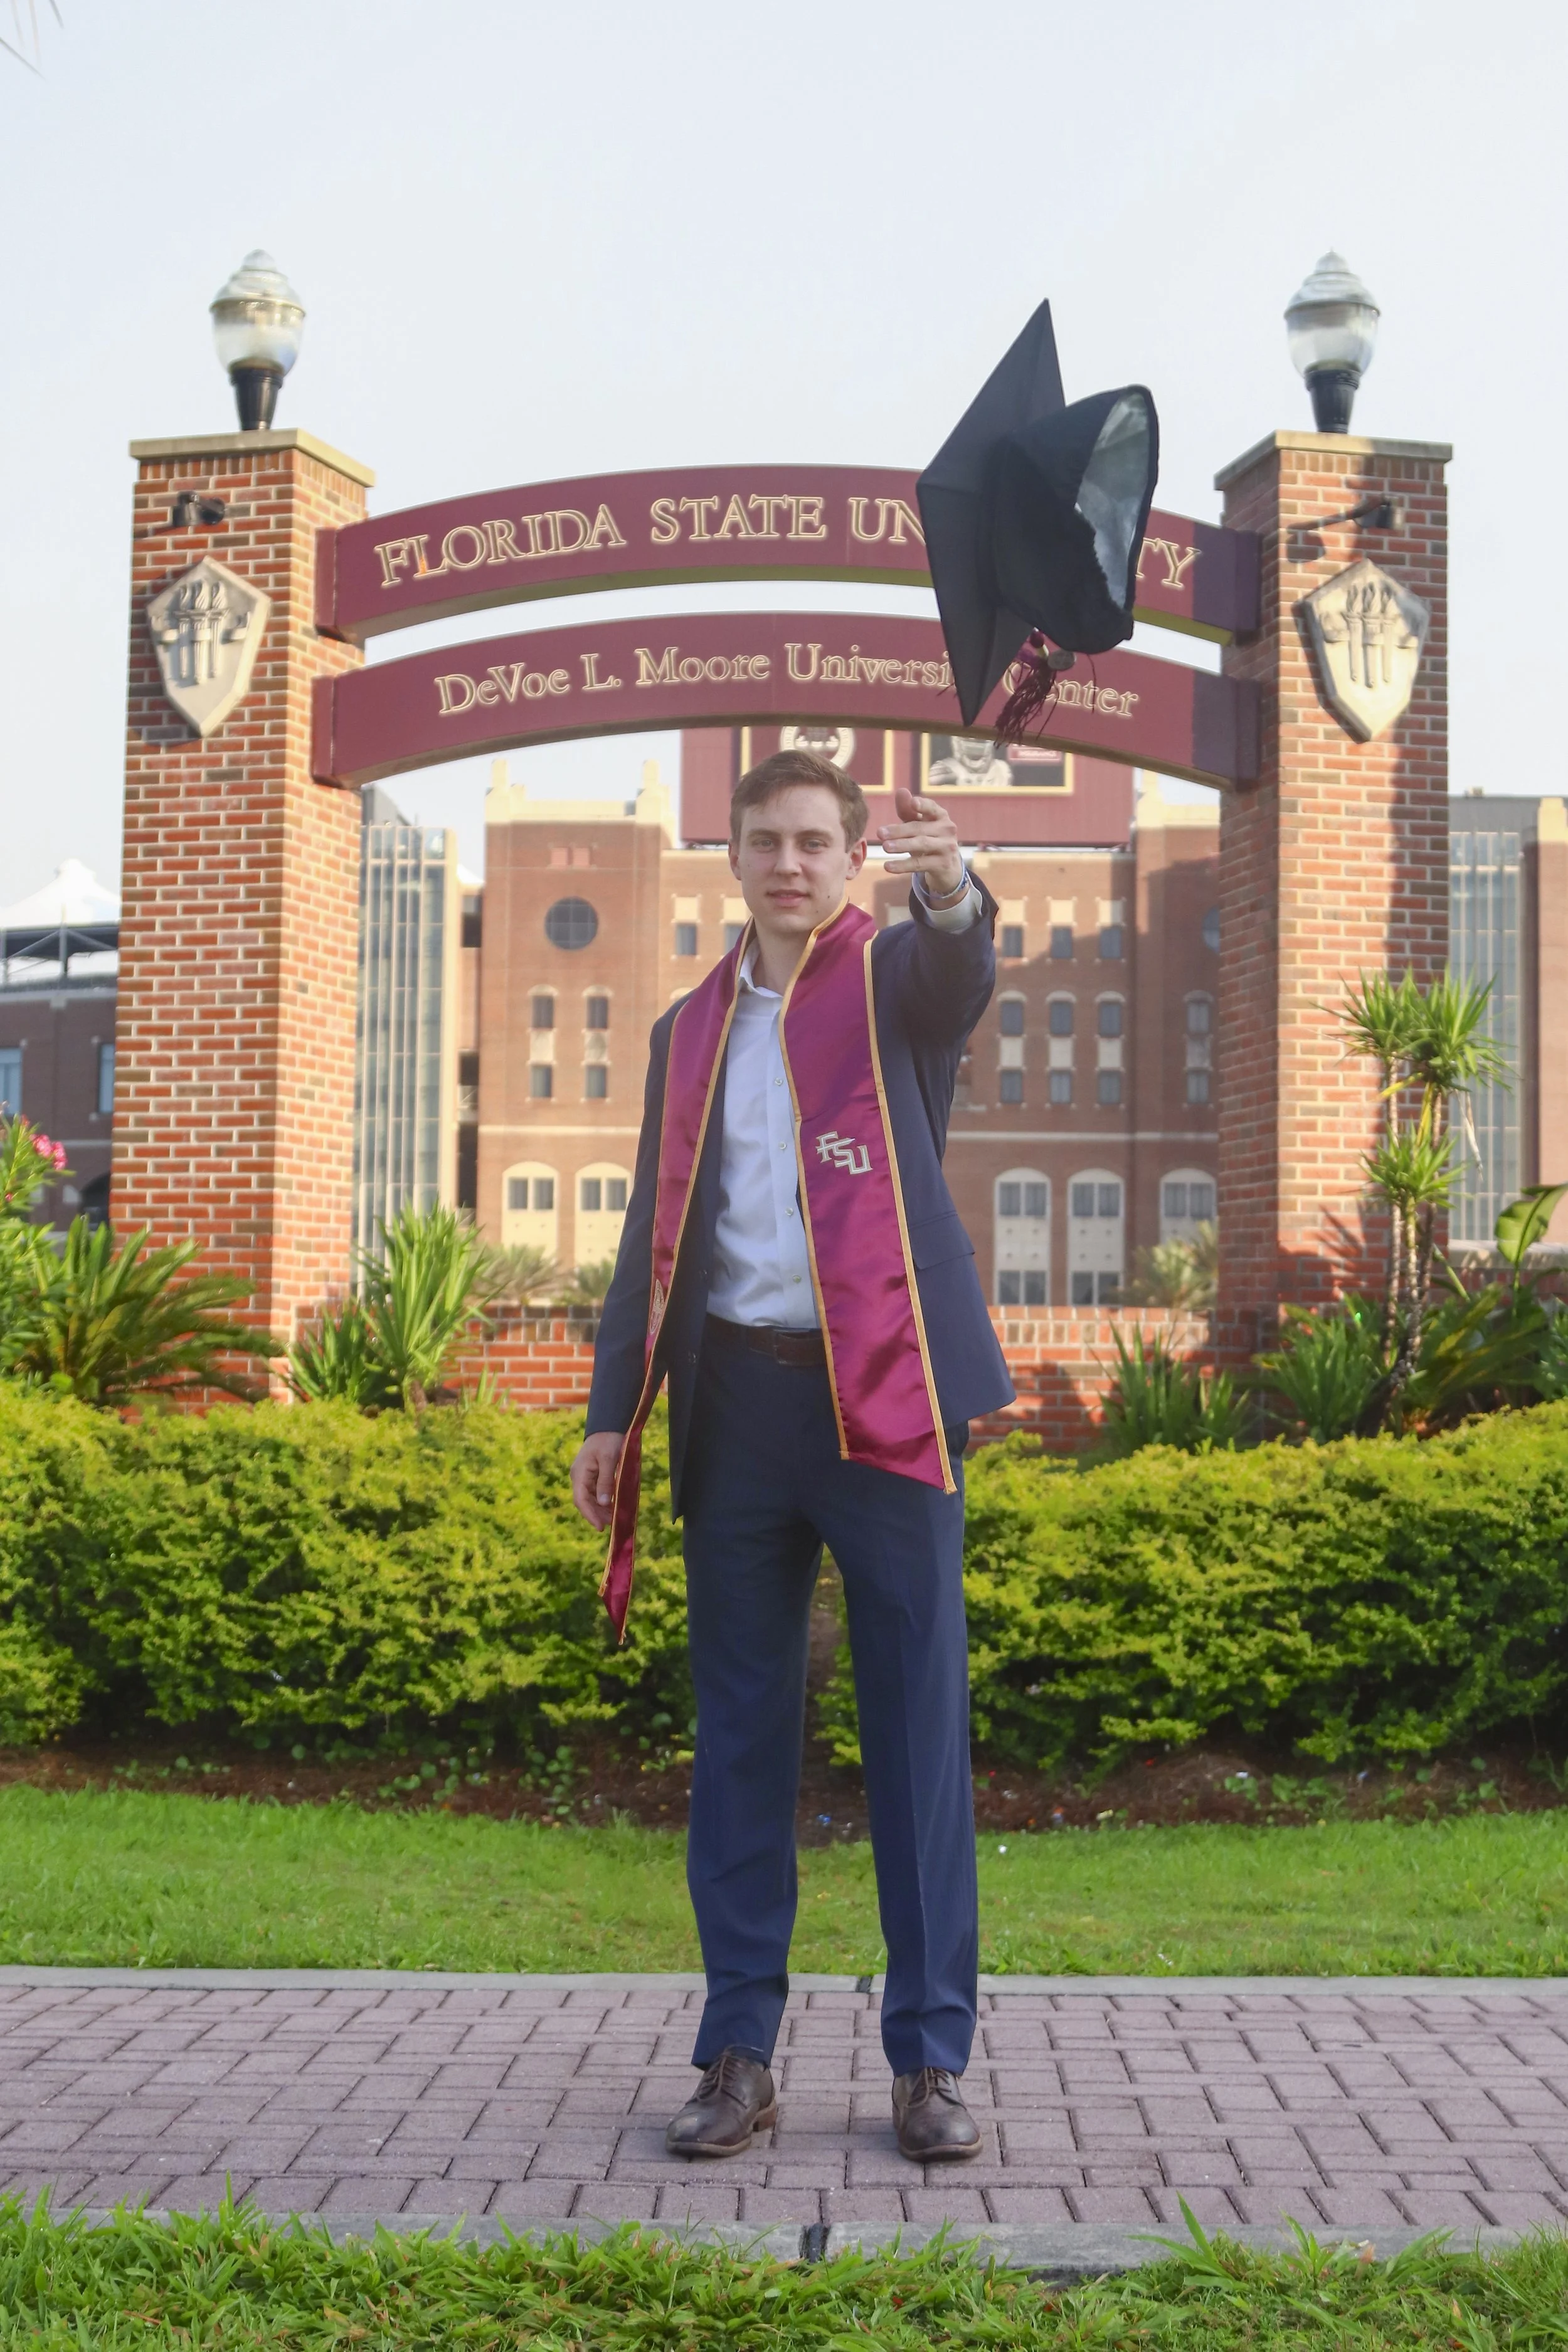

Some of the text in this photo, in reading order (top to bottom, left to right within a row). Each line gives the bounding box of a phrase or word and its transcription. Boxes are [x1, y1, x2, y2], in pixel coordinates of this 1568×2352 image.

[375, 504, 626, 587] FLORIDA
[651, 494, 827, 543] STATE
[435, 644, 1139, 716] DeVoe L. Moore Universi Cnter
[815, 1131, 873, 1175] FSU
